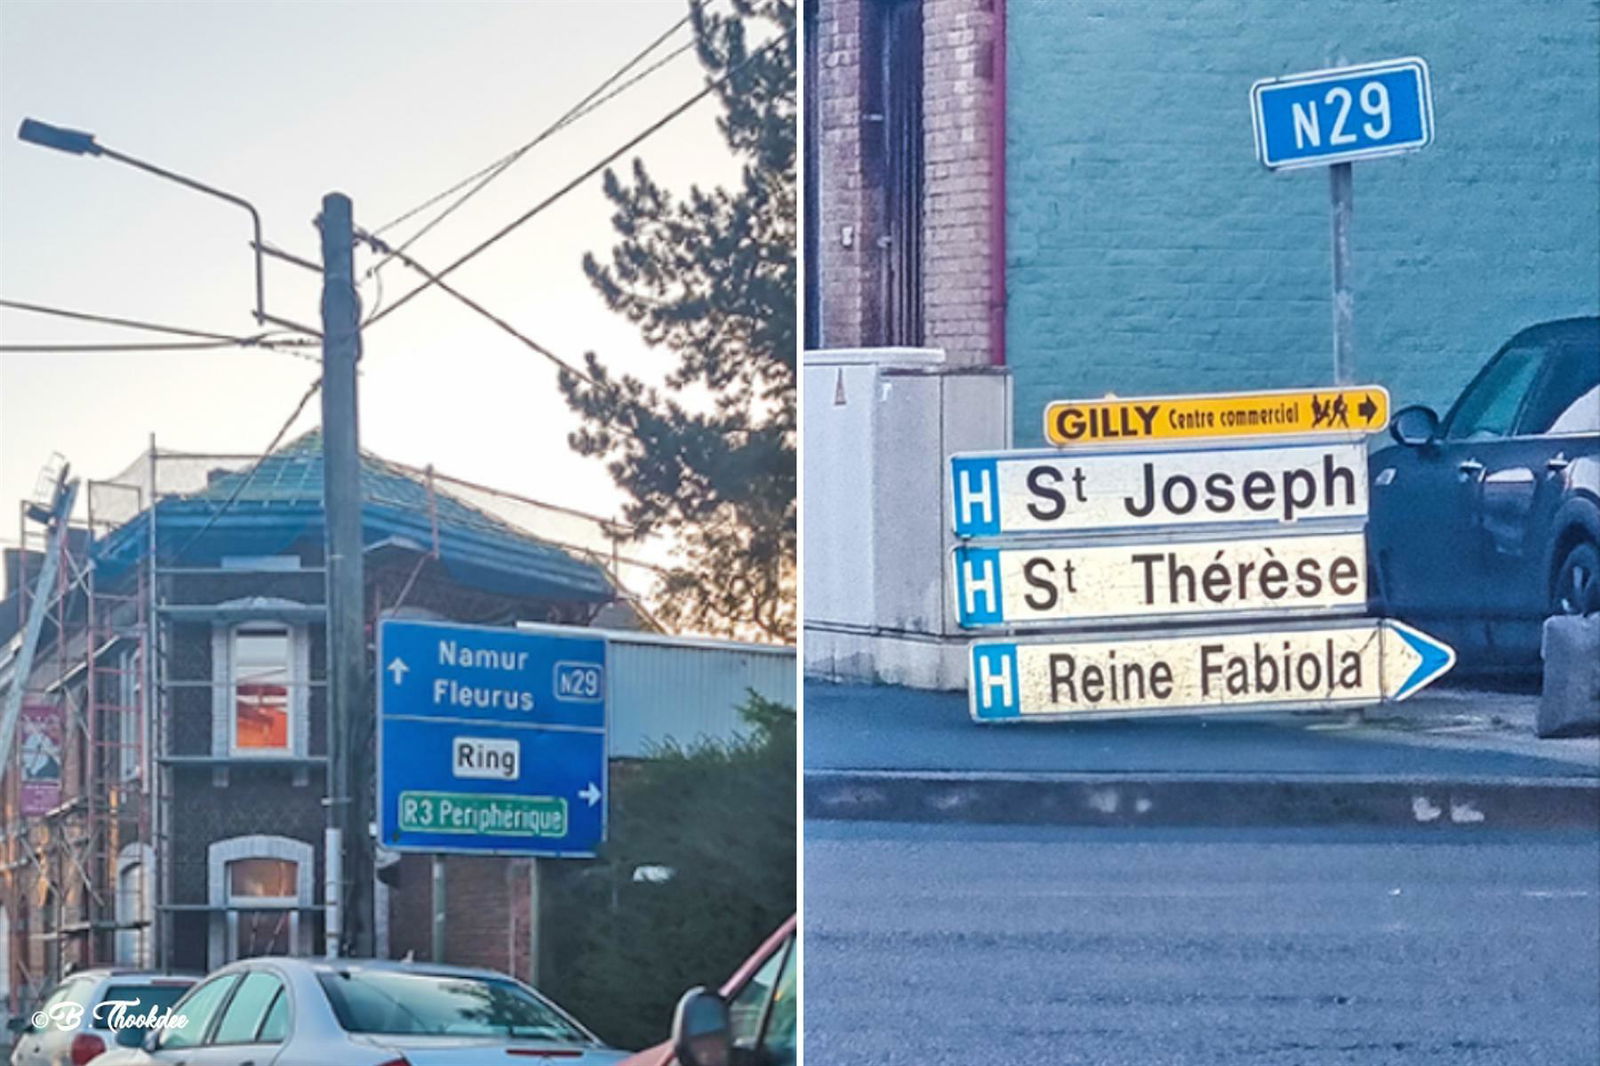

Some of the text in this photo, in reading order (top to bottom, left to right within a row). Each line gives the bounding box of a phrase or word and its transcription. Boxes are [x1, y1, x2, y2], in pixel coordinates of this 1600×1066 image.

[1292, 82, 1391, 149] N29
[1056, 402, 1299, 439] GILLY Centre commercial
[960, 453, 1356, 523] H St Joseph
[962, 547, 1358, 614] H St Thérèse
[438, 640, 528, 670] Namur
[560, 669, 598, 696] N29
[980, 638, 1363, 708] H Reine Fabiola
[433, 679, 534, 711] Fleurus
[457, 743, 516, 777] Ring
[403, 799, 435, 826] R3
